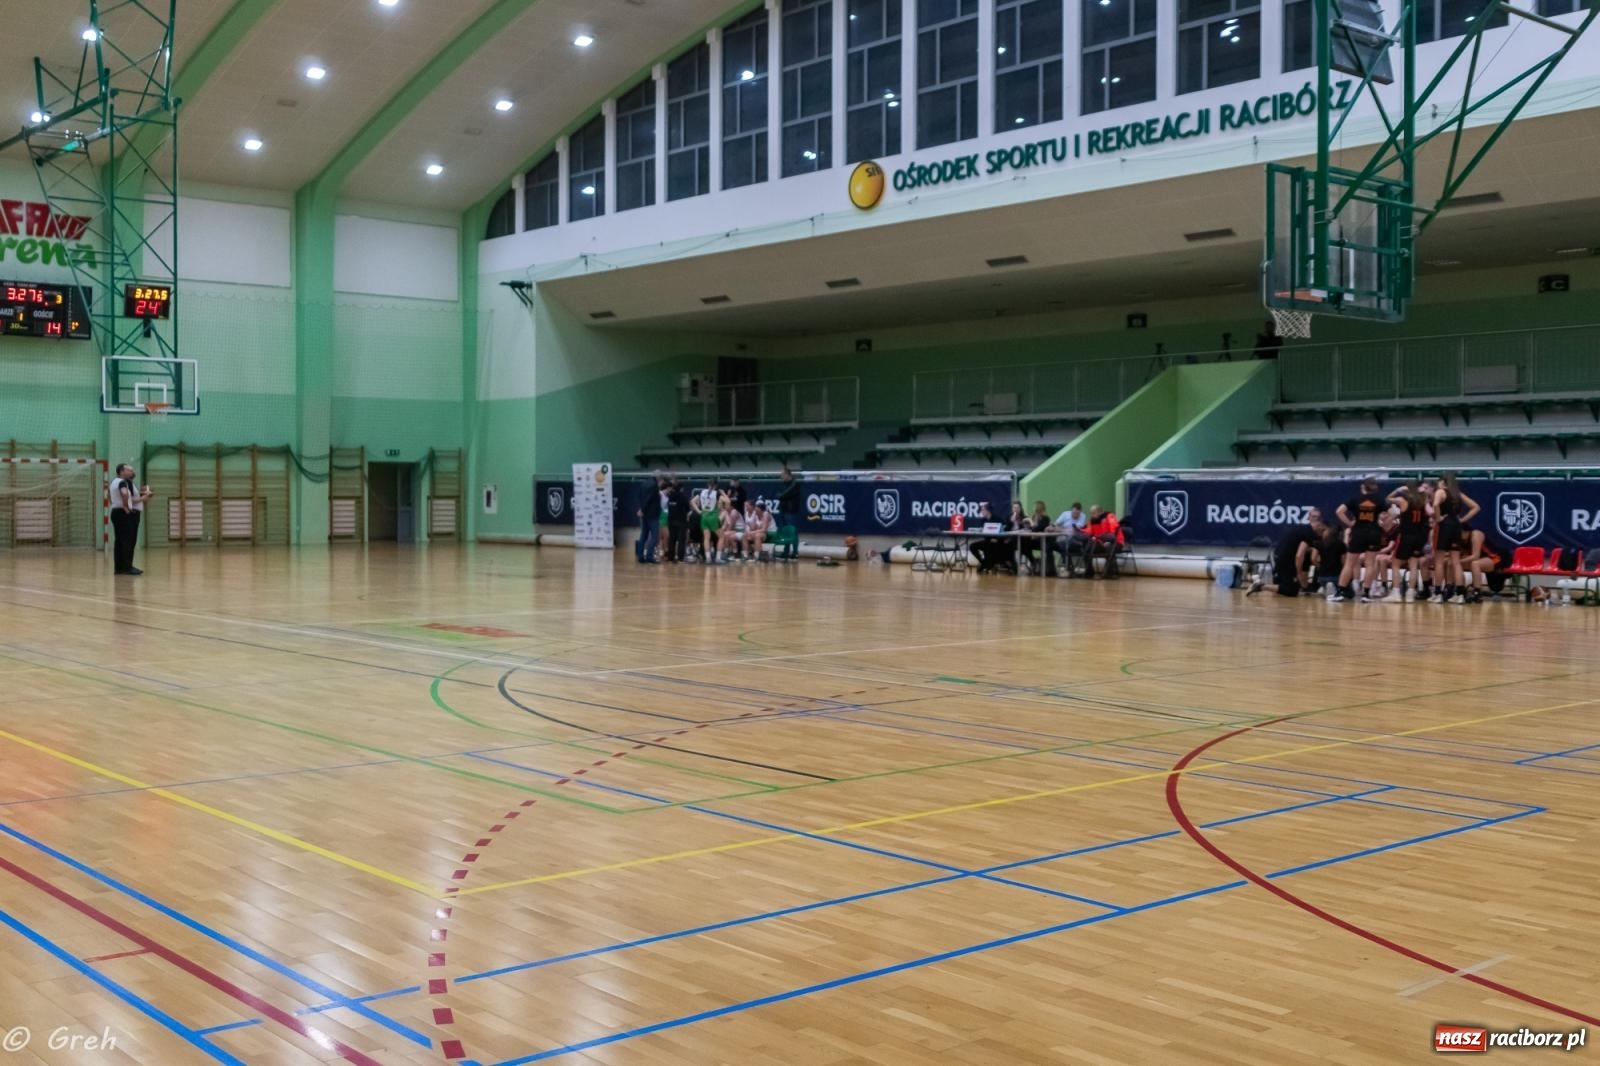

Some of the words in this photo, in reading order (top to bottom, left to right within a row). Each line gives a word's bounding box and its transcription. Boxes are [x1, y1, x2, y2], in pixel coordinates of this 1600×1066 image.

[893, 153, 980, 192] OŚRODEK
[986, 136, 1067, 175] SPORTU
[1073, 133, 1081, 159] I
[1088, 107, 1210, 155] REKREACJI
[135, 300, 159, 315] 24
[47, 322, 62, 334] 14
[1207, 499, 1314, 525] RACIBÓRZ
